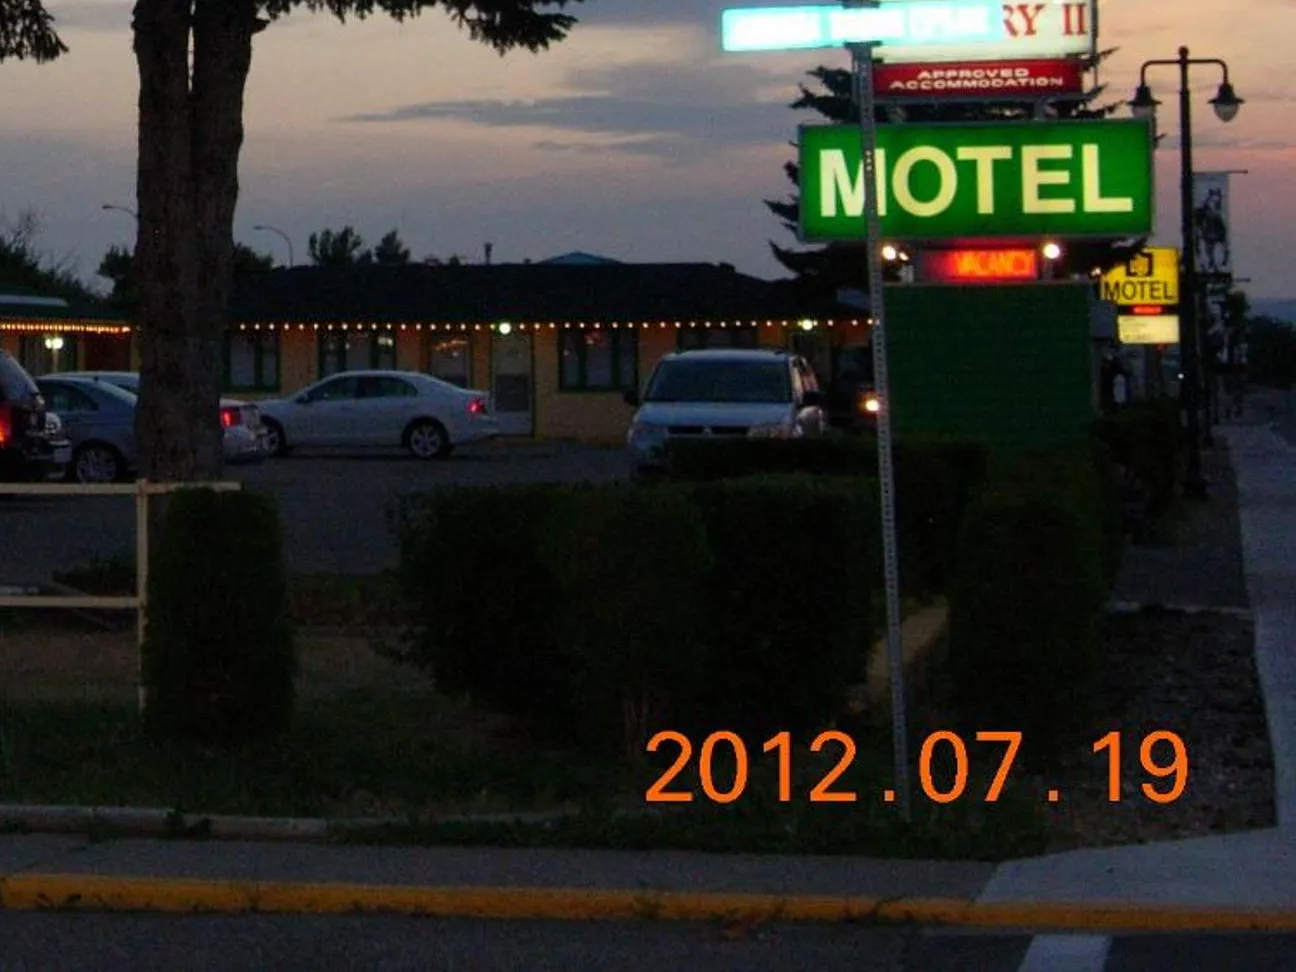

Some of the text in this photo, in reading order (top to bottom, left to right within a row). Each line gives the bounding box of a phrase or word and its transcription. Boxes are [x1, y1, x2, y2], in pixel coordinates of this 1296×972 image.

[1062, 2, 1087, 37] II
[888, 76, 1065, 91] ACCOMMODATION
[917, 67, 1030, 80] APPROVED
[819, 143, 1135, 218] MOTEL
[1102, 280, 1176, 301] MOTEL
